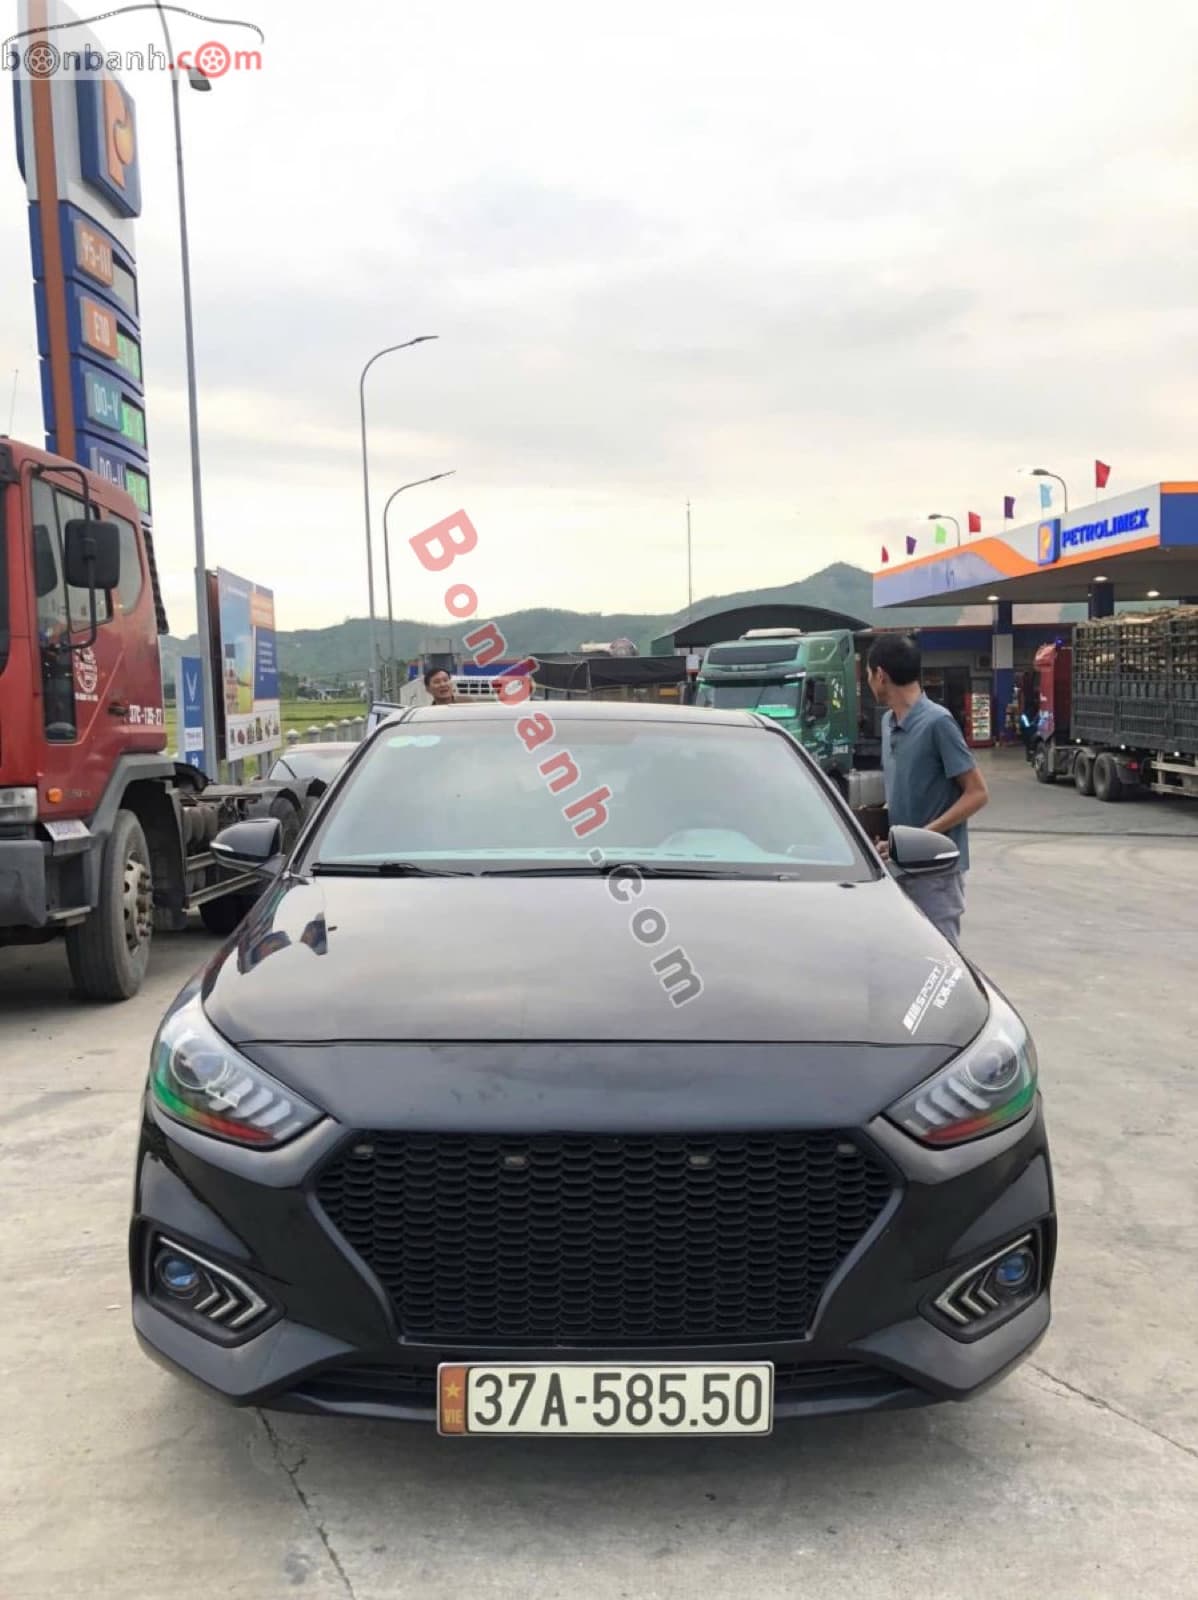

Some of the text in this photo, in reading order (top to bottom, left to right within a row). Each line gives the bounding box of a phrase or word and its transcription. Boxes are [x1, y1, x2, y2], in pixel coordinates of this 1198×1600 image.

[1062, 507, 1149, 548] PETROLIMEX
[915, 964, 942, 1007] SPORT
[444, 1409, 463, 1425] VIE
[474, 1372, 763, 1427] 37A-585.50
